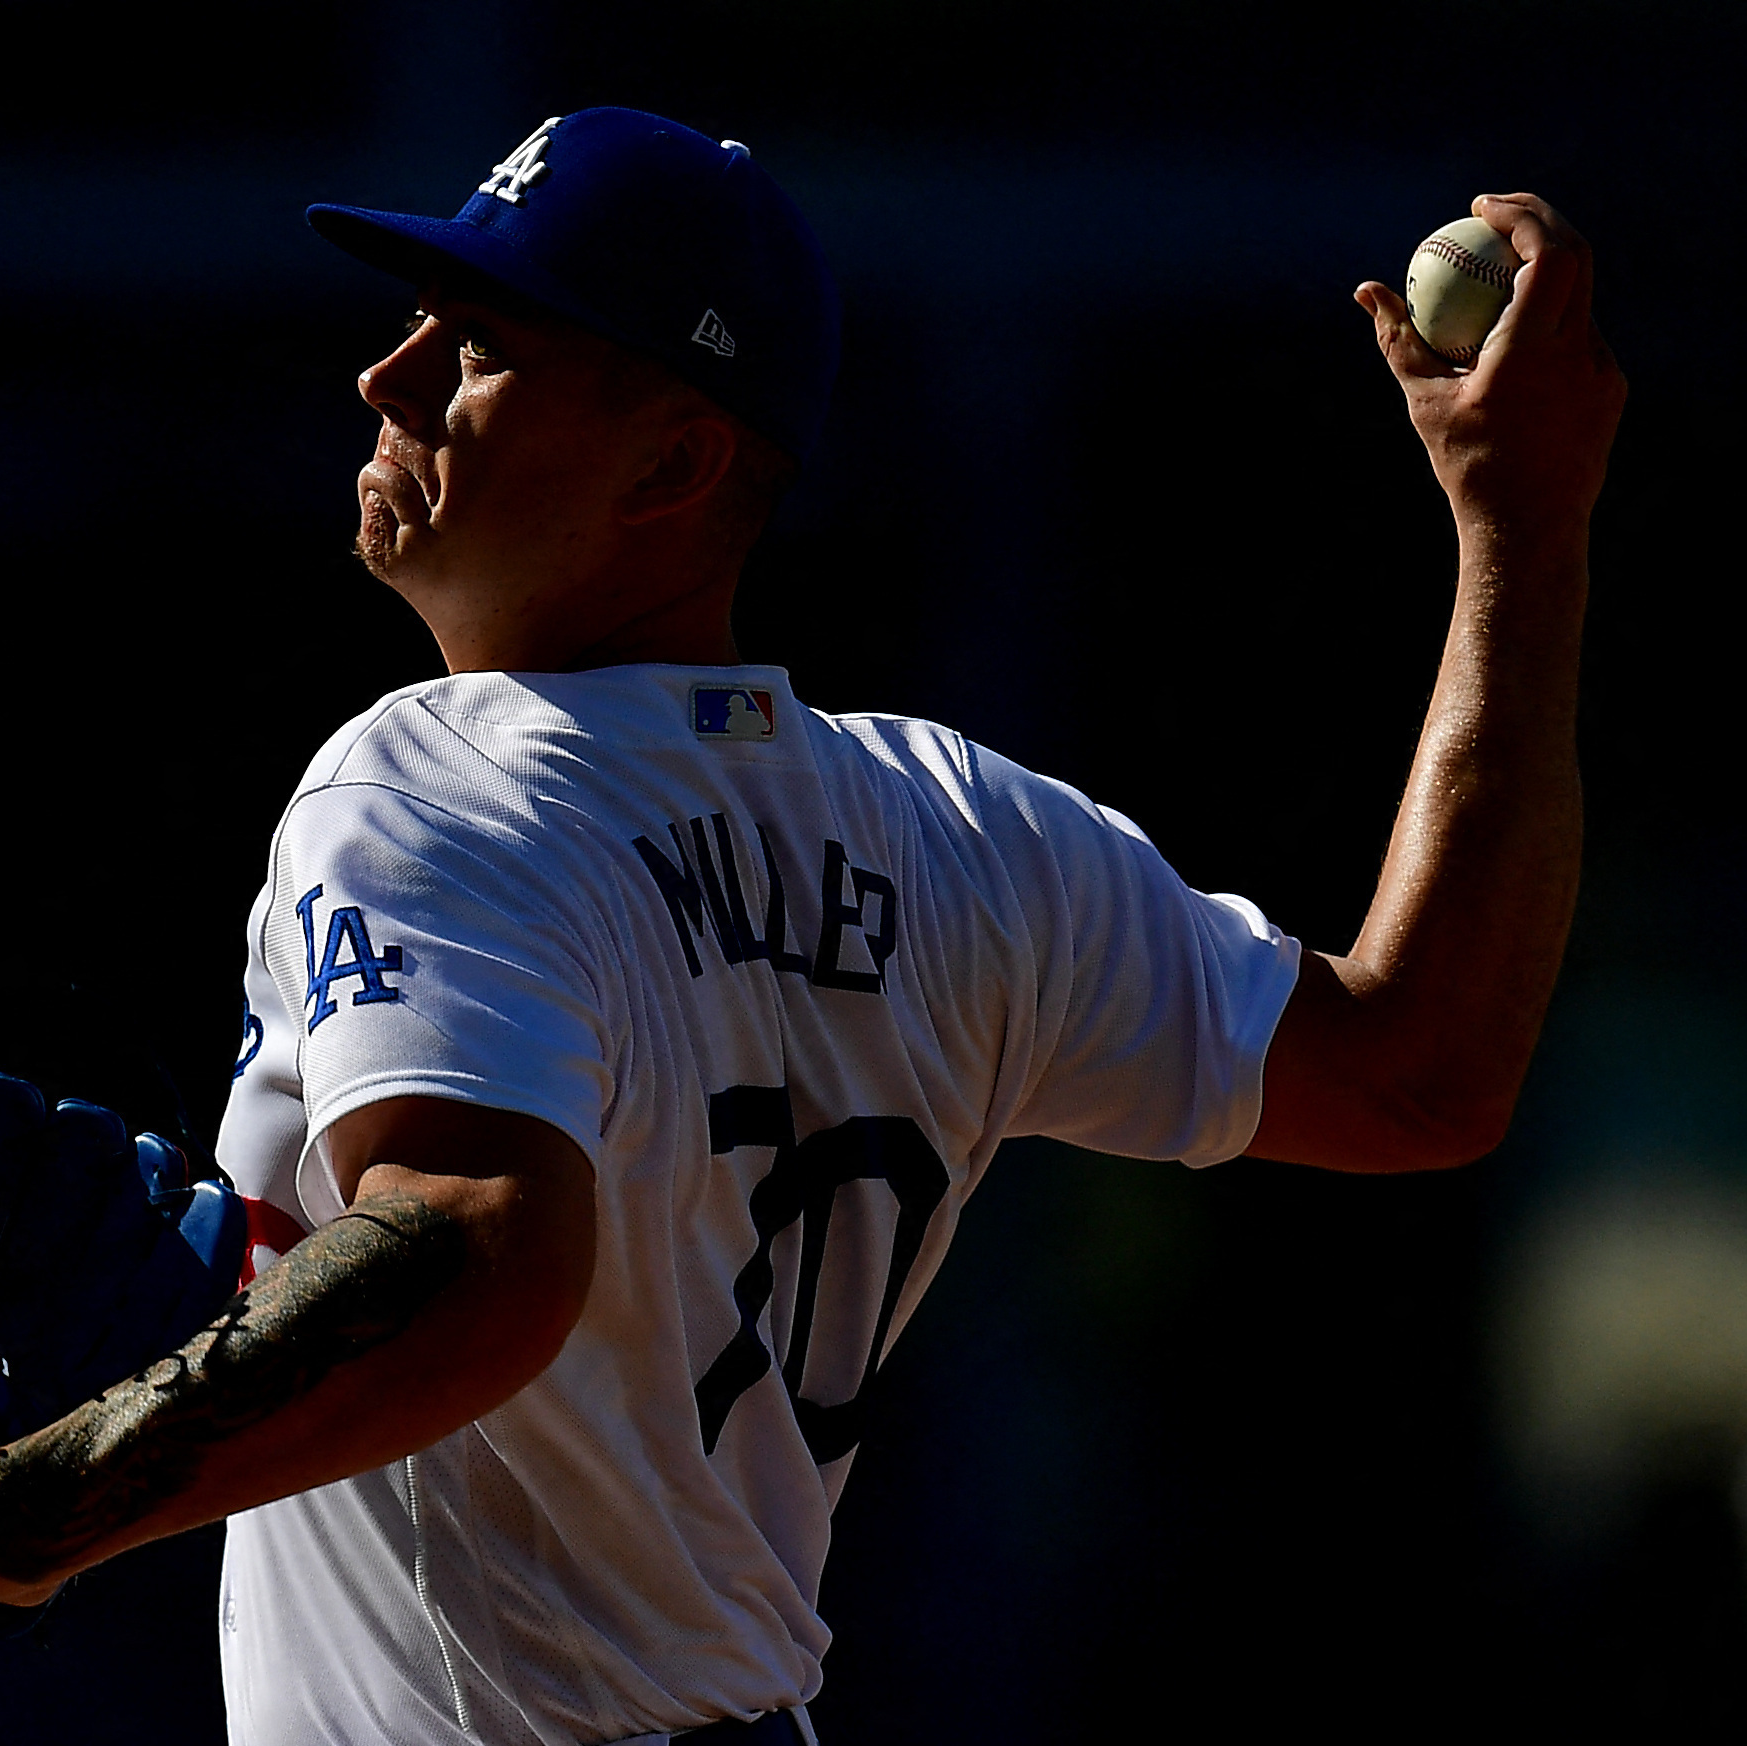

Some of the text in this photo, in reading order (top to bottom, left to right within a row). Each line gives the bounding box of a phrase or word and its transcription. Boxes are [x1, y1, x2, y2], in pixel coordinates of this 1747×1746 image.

[478, 116, 562, 204] LA
[296, 883, 402, 1036] LA
[632, 813, 896, 995] MILLER
[694, 1085, 951, 1465] 70
